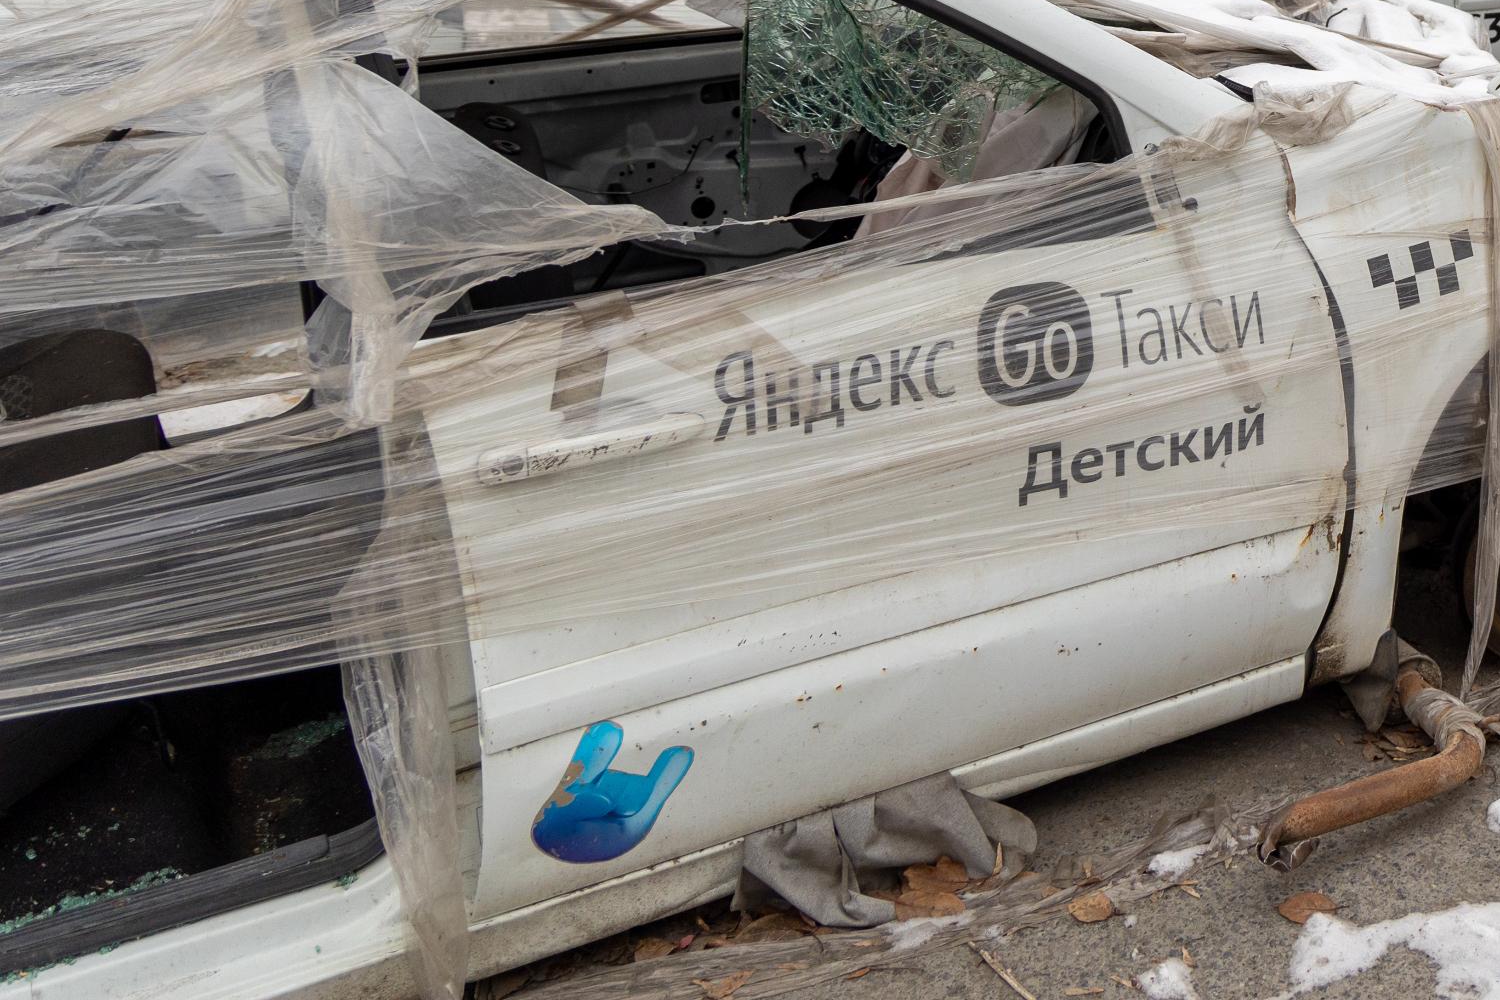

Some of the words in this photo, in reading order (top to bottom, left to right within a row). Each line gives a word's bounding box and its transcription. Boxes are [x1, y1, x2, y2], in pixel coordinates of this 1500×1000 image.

[713, 338, 957, 442] Яндекс
[994, 304, 1081, 389] Go
[1101, 289, 1265, 369] Такси
[1018, 404, 1265, 507] Детский
